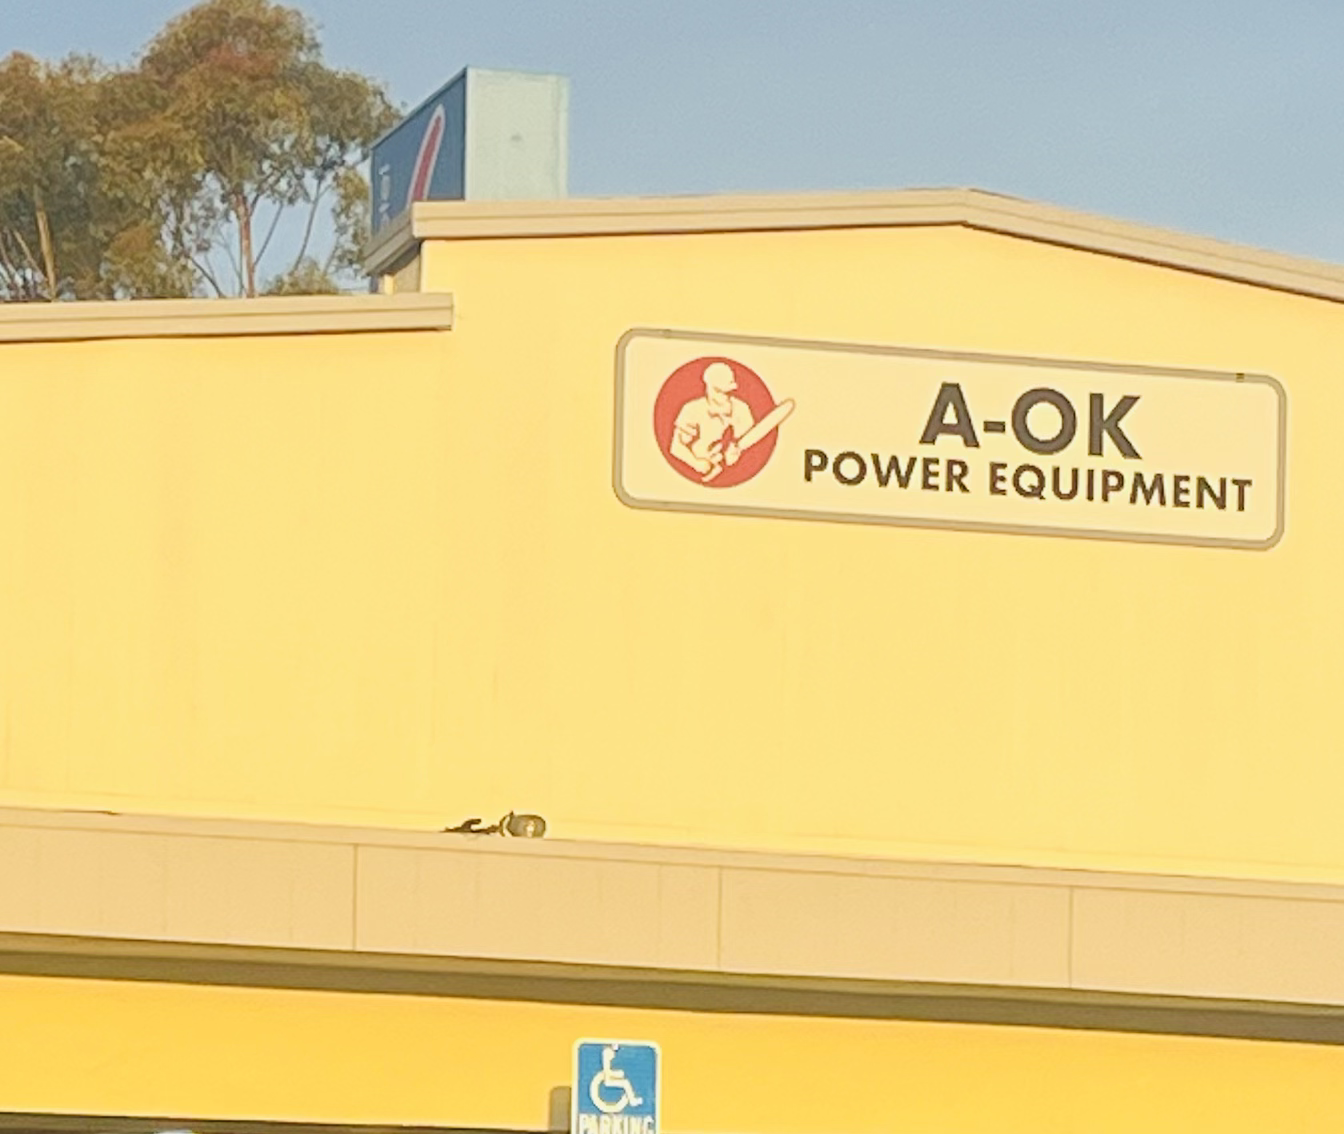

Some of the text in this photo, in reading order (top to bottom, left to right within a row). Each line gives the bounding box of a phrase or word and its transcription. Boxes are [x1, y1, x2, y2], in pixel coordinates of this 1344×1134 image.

[919, 382, 1142, 460] A-OK
[804, 448, 1253, 512] POWER EQUIPMENT
